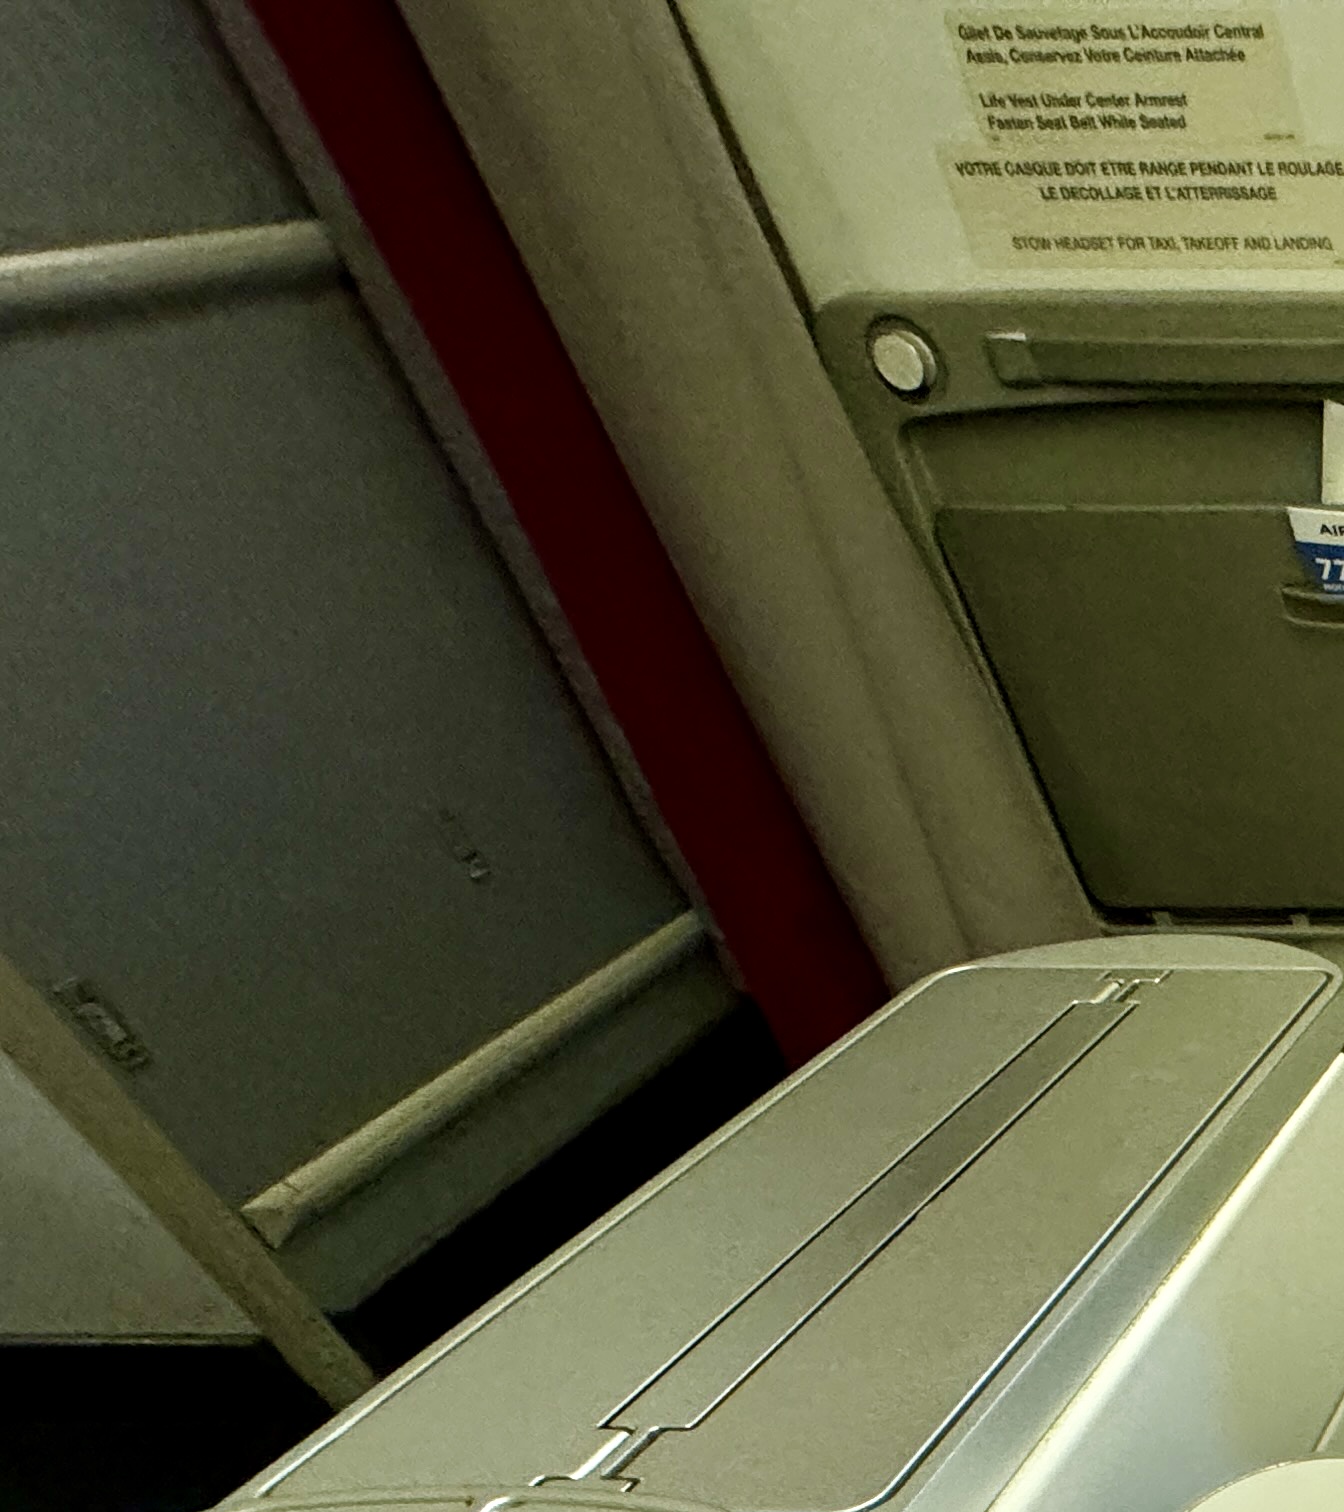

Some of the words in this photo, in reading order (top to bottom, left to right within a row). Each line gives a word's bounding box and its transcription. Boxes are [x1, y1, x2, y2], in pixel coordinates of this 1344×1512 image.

[958, 24, 989, 40] Gilet
[993, 24, 1013, 40] De
[1016, 24, 1087, 43] Sauvetage
[1090, 24, 1126, 40] Sous
[1127, 24, 1209, 40] L'Accoudoir
[1214, 23, 1264, 40] Central
[1009, 48, 1082, 64] Conservez
[1084, 47, 1121, 63] Votre
[1123, 47, 1182, 63] Ceinture
[1186, 47, 1245, 63] Attachée
[979, 92, 1006, 108] Life
[1008, 93, 1038, 108] Vest
[1040, 93, 1081, 108] Under
[1085, 91, 1130, 108] Center
[1135, 92, 1187, 107] Armrest
[987, 115, 1034, 131] Fasten
[1036, 115, 1068, 130] Seat
[1069, 115, 1098, 130] Belt
[1097, 115, 1136, 130] While
[1139, 114, 1187, 130] Seated
[955, 161, 1002, 177] VOTRE
[1005, 161, 1060, 177] CASQUE
[1064, 161, 1097, 176] DOIT
[1101, 161, 1136, 176] ETRE
[1139, 161, 1187, 176] RANGE
[1190, 161, 1253, 176] PENDANT
[1257, 161, 1275, 176] LE
[1039, 186, 1059, 201] LE
[1061, 186, 1142, 201] DECOLLAGE
[1146, 186, 1161, 201] ET
[1164, 186, 1278, 201] L'ATTERRISSAGE
[1012, 236, 1052, 251] STOW
[1054, 236, 1113, 251] HEADSET
[1117, 236, 1146, 251] FOR
[1181, 236, 1239, 251] TAKEOFF
[1244, 236, 1270, 251] AND
[1274, 236, 1333, 251] LANDING
